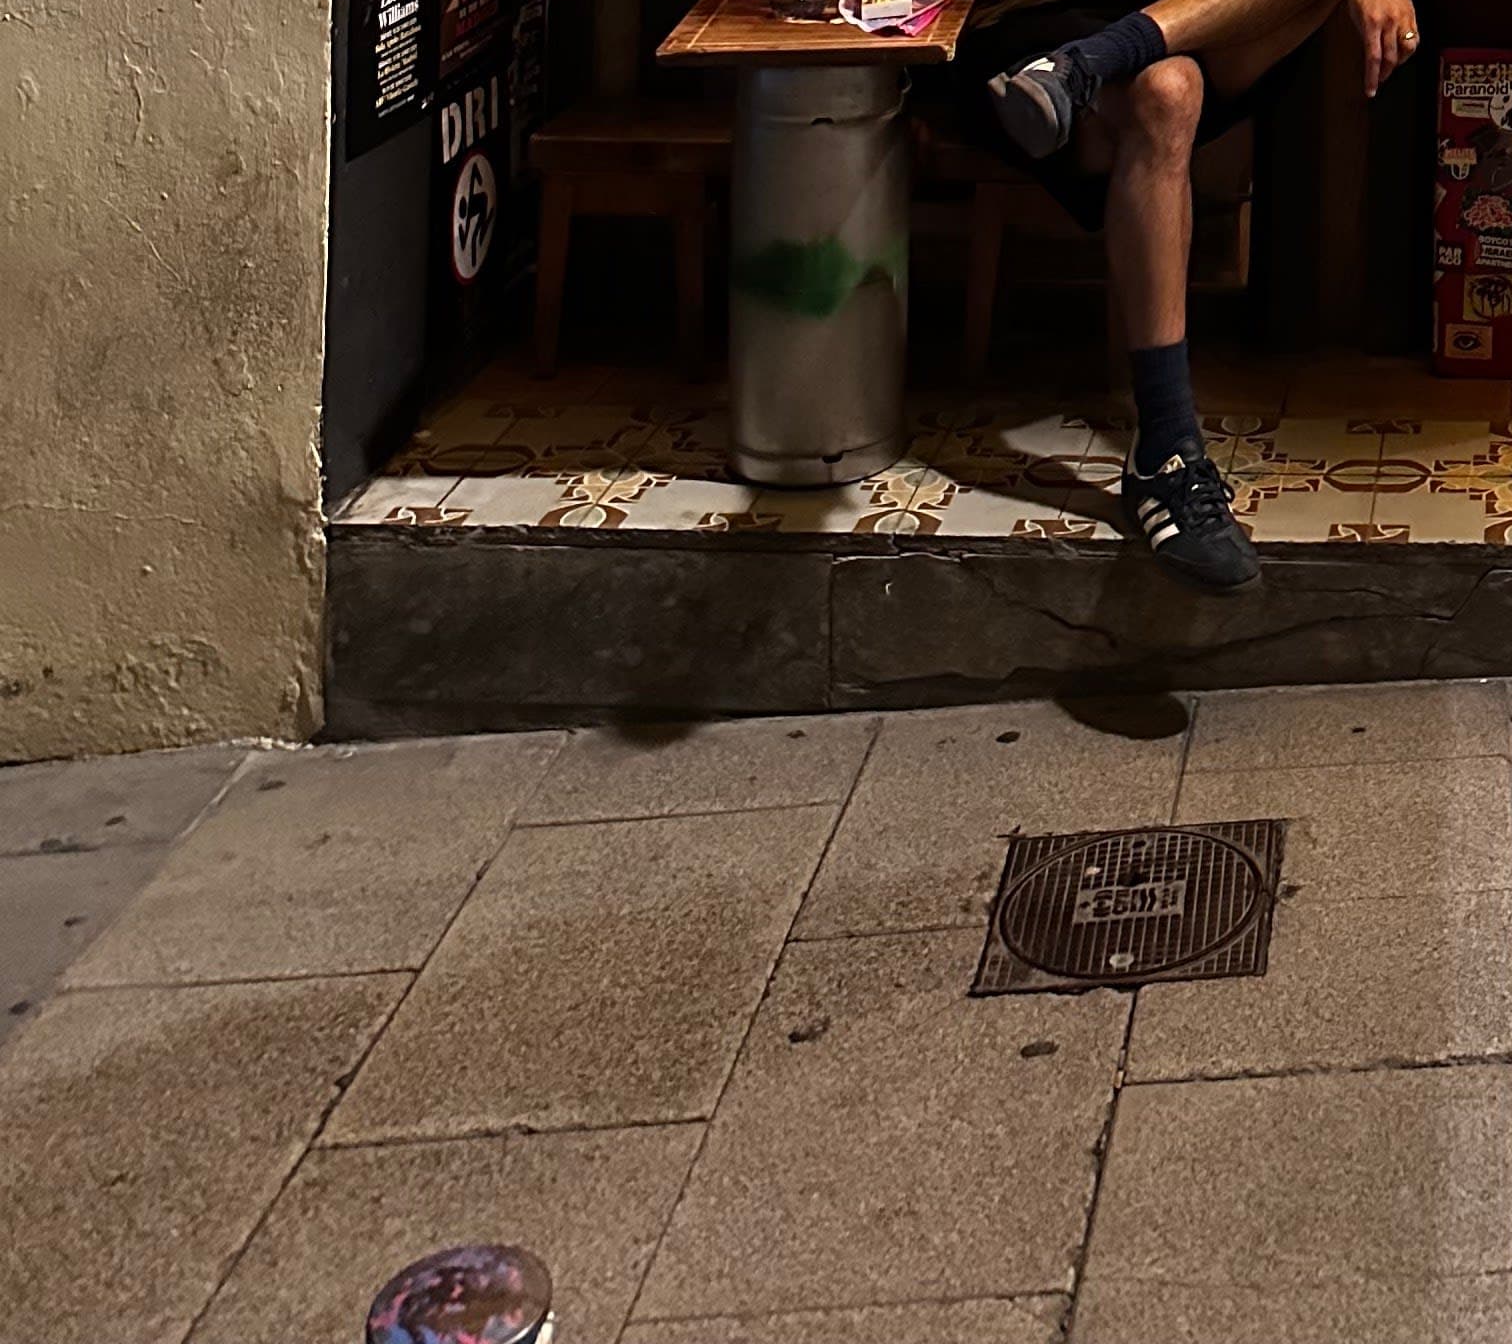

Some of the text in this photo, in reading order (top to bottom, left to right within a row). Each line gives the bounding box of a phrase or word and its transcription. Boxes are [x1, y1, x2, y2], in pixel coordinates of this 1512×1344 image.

[378, 0, 419, 30] Williams
[1444, 81, 1510, 97] Paranoid
[442, 75, 498, 165] DRI
